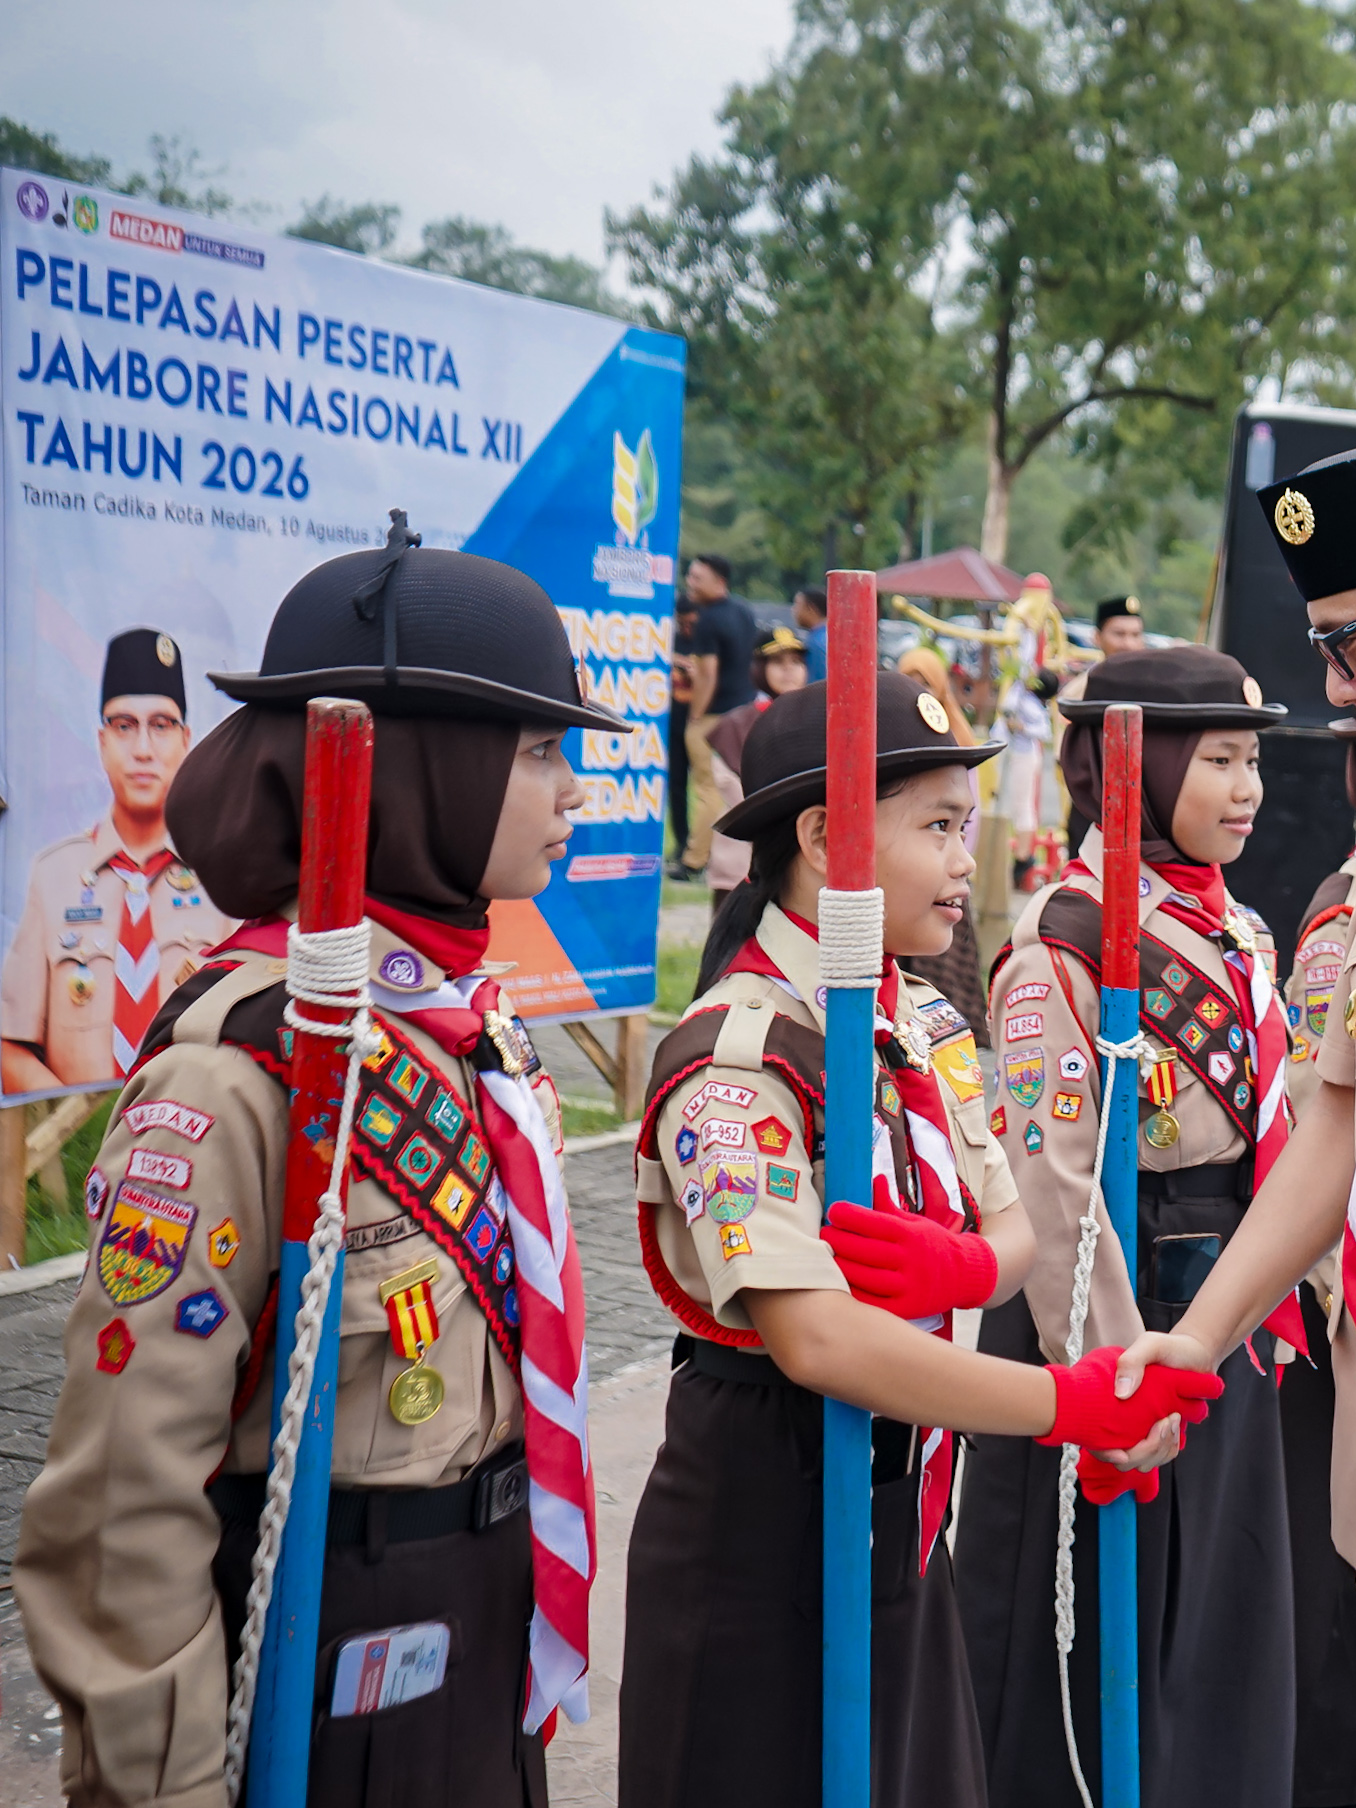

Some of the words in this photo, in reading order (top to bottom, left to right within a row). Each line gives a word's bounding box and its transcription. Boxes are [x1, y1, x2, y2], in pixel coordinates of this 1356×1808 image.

[113, 215, 180, 249] MEDAN
[185, 234, 221, 257] UNTUK
[224, 246, 261, 266] SEMUA
[16, 247, 281, 351] PELEPASAN
[298, 312, 461, 390] PESERTA
[18, 331, 249, 419] JAMBORE
[265, 378, 468, 457] NASIONAL
[482, 417, 523, 463] XII
[17, 409, 182, 483] TAHUN
[200, 440, 309, 500] 2026
[21, 483, 86, 511] Taman
[94, 492, 156, 520] Cadika
[164, 501, 204, 527] Kota
[211, 507, 271, 536] Medan,
[281, 515, 299, 537] 10
[306, 519, 369, 545] Agustus
[582, 723, 665, 767] KOTA
[570, 773, 663, 820] EDAN
[133, 1106, 201, 1133] MEDAN
